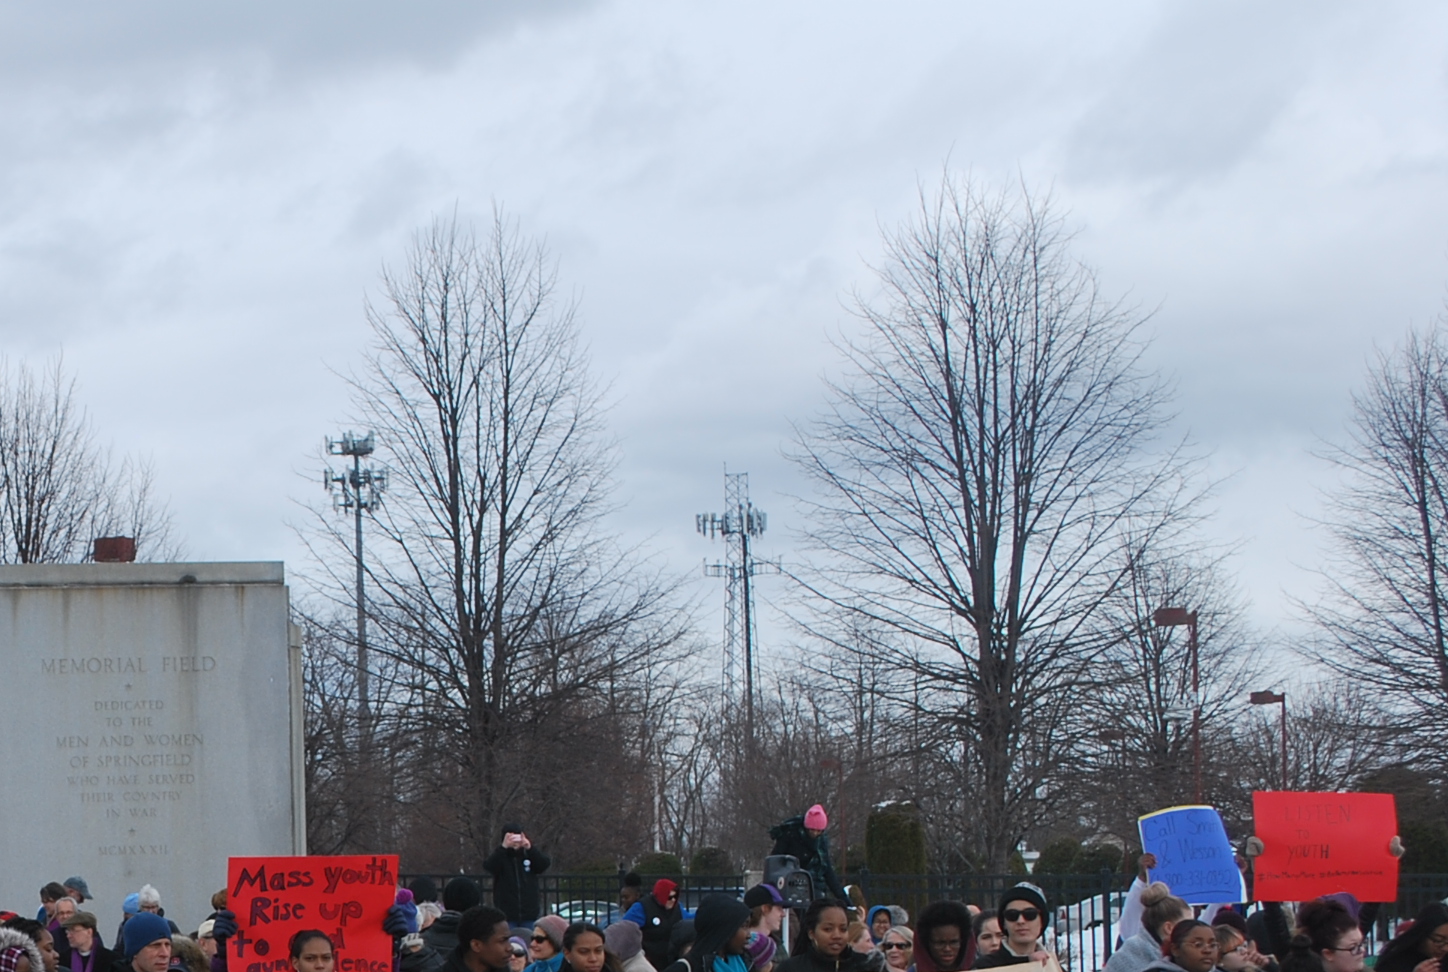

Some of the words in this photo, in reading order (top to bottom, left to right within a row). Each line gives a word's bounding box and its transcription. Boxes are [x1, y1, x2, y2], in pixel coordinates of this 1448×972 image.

[41, 656, 148, 674] MEMORIAL
[162, 655, 217, 673] FIELD
[94, 700, 164, 711] DEDICATED
[105, 717, 123, 727] TO
[131, 716, 153, 727] THE
[56, 736, 89, 748] MEN
[99, 735, 134, 747] AND
[144, 734, 204, 746] WOMEN
[69, 756, 89, 768] OF
[97, 754, 192, 767] SPRINGFIELD
[67, 775, 100, 786] WHO
[107, 775, 140, 785] HAVE
[148, 774, 195, 785] SERVED
[80, 793, 115, 803] THEIR
[106, 808, 120, 818] IN
[129, 808, 158, 818] WAR
[1285, 804, 1351, 824] LISTEN
[1144, 815, 1177, 842] Call
[1296, 829, 1311, 840] TO
[1177, 838, 1223, 864] Wesson
[1287, 844, 1331, 866] YOUTH
[232, 865, 315, 898] Mass
[322, 857, 395, 894] youth
[249, 896, 305, 927] Rise
[318, 901, 364, 927] up
[232, 930, 270, 958] to
